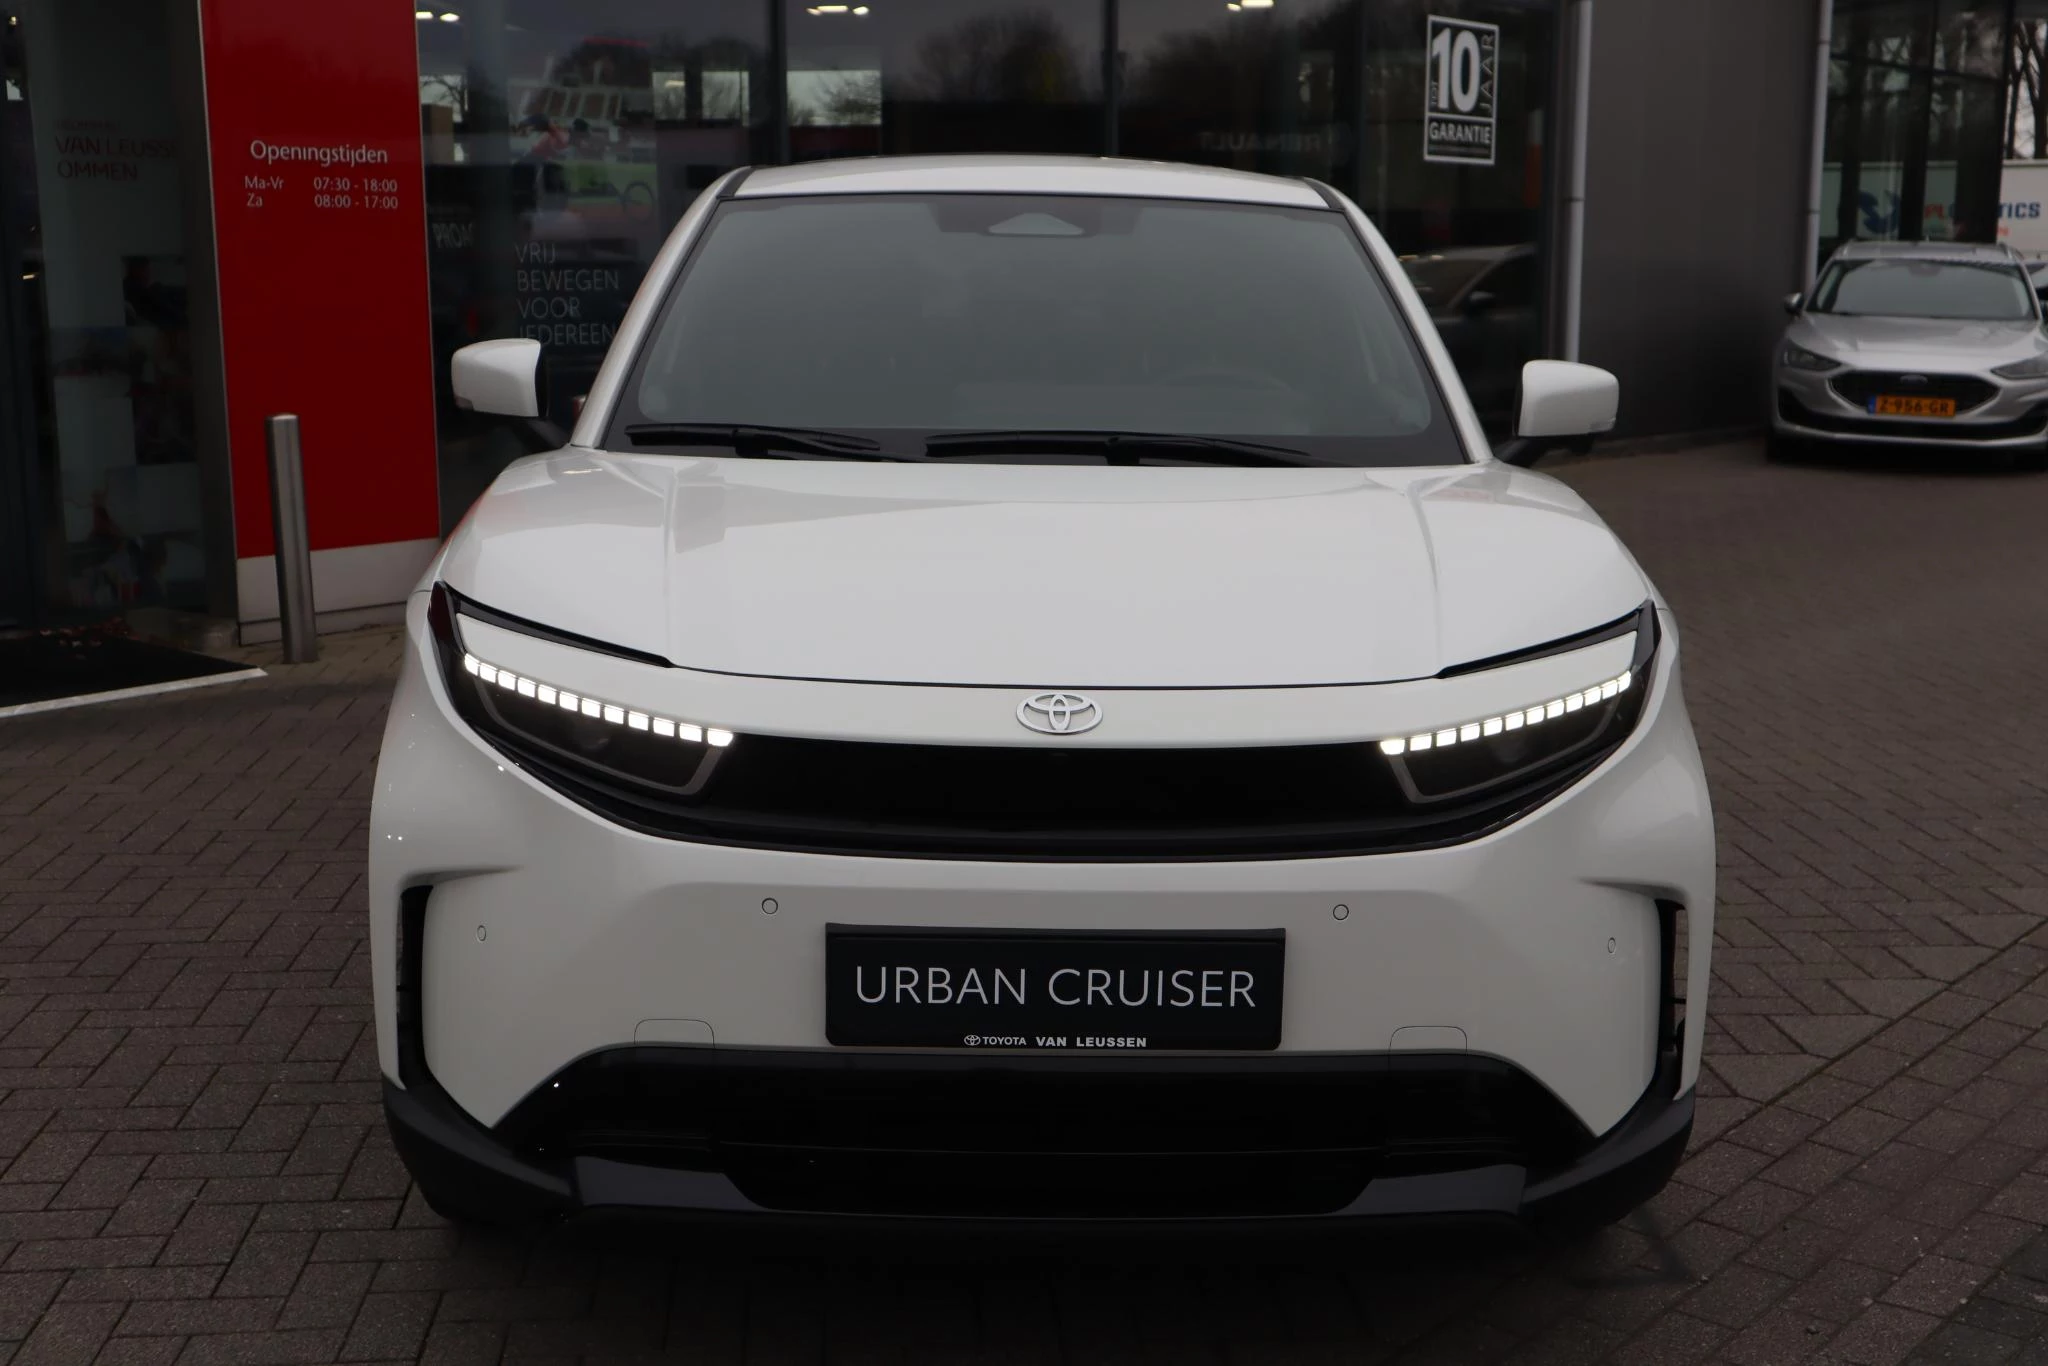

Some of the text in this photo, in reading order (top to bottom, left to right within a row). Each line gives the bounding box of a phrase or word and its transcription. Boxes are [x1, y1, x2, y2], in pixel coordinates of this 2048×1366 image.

[1432, 27, 1480, 113] 10
[1479, 34, 1494, 116] JAAR
[1429, 121, 1490, 144] GARANTIE
[55, 135, 100, 154] VAN
[250, 140, 388, 168] Openingstijden
[57, 160, 138, 180] OMMEN
[244, 175, 284, 190] Ma-Vr
[313, 177, 351, 191] 07:30
[363, 178, 398, 193] 18:00
[246, 192, 263, 207] Za
[314, 194, 351, 208] 08:00
[364, 195, 399, 209] 17:00
[515, 241, 557, 264] VRIJ
[517, 268, 620, 292] BEWEGEN
[516, 296, 582, 320] VOOR
[856, 965, 1257, 1008] URBAN CRUISER
[982, 1035, 1147, 1048] TOYOTA VAN LEUSSEN
